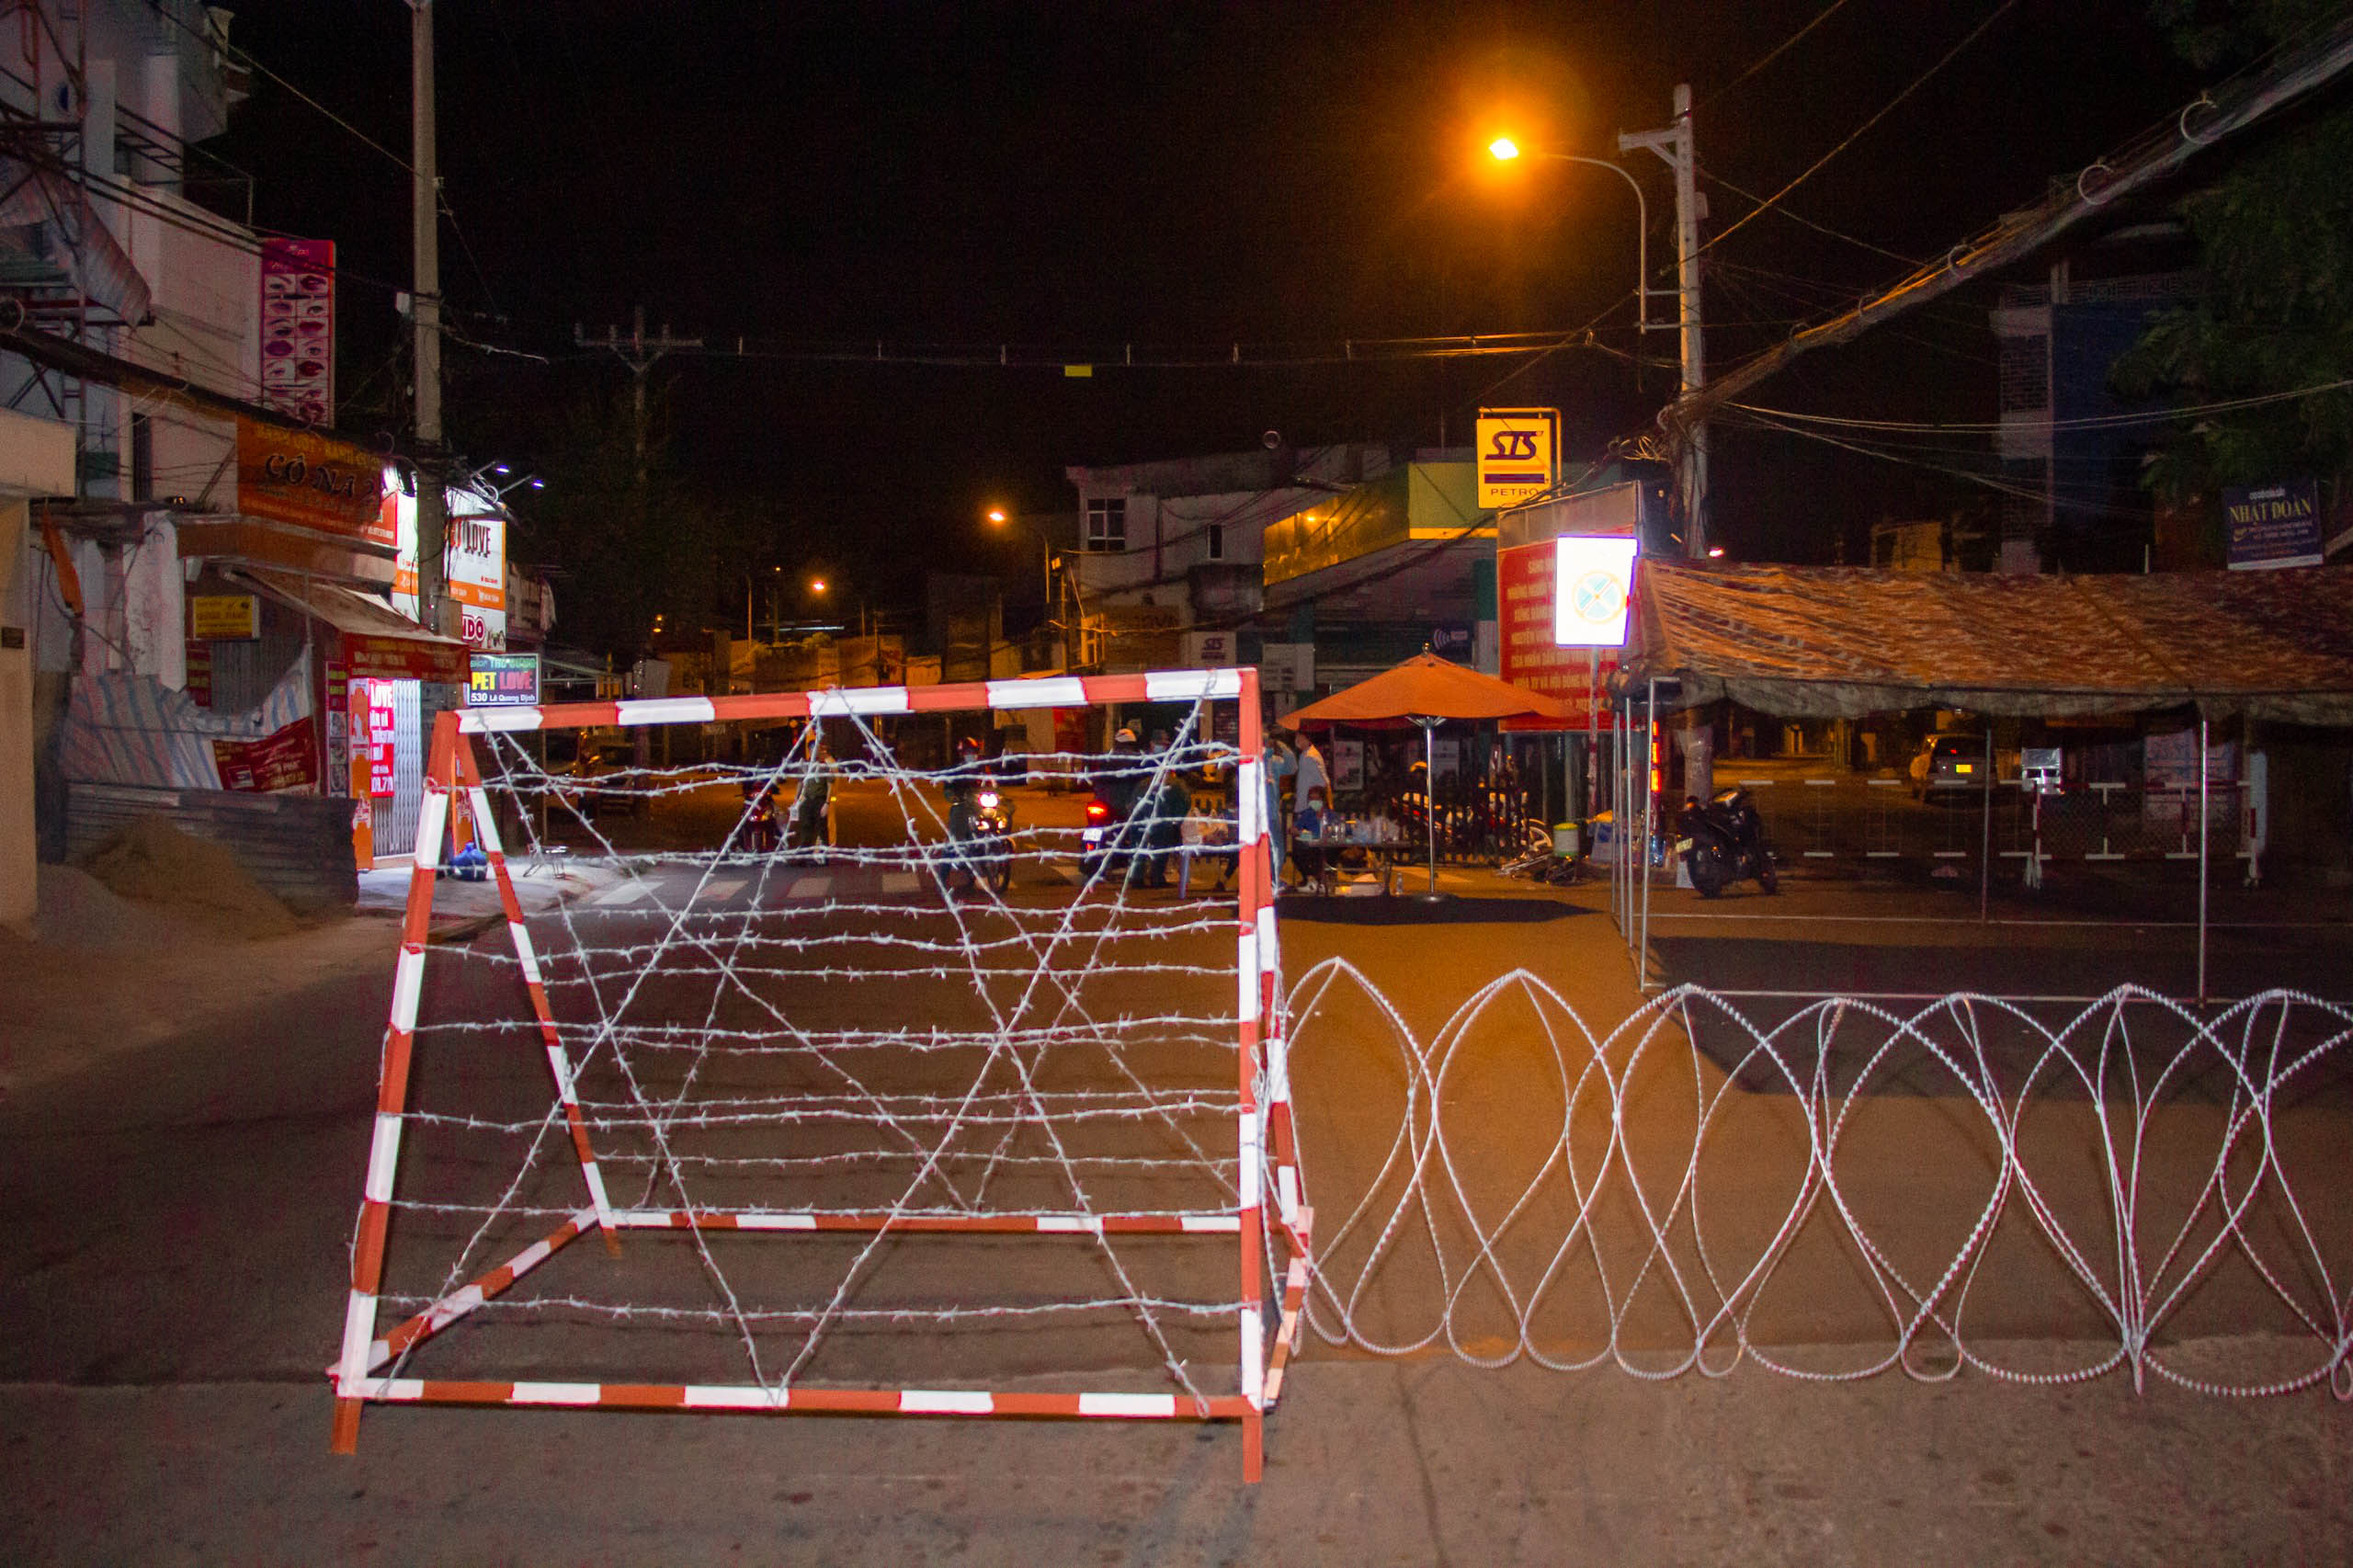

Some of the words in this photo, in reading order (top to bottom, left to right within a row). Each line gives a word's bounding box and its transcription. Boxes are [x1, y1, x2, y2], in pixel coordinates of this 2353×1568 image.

[1484, 430, 1538, 460] STS
[1491, 488, 1539, 496] PETRO
[472, 671, 496, 690] PET
[499, 671, 533, 690] LOVE
[471, 693, 488, 702] 530
[498, 694, 519, 703] Quang
